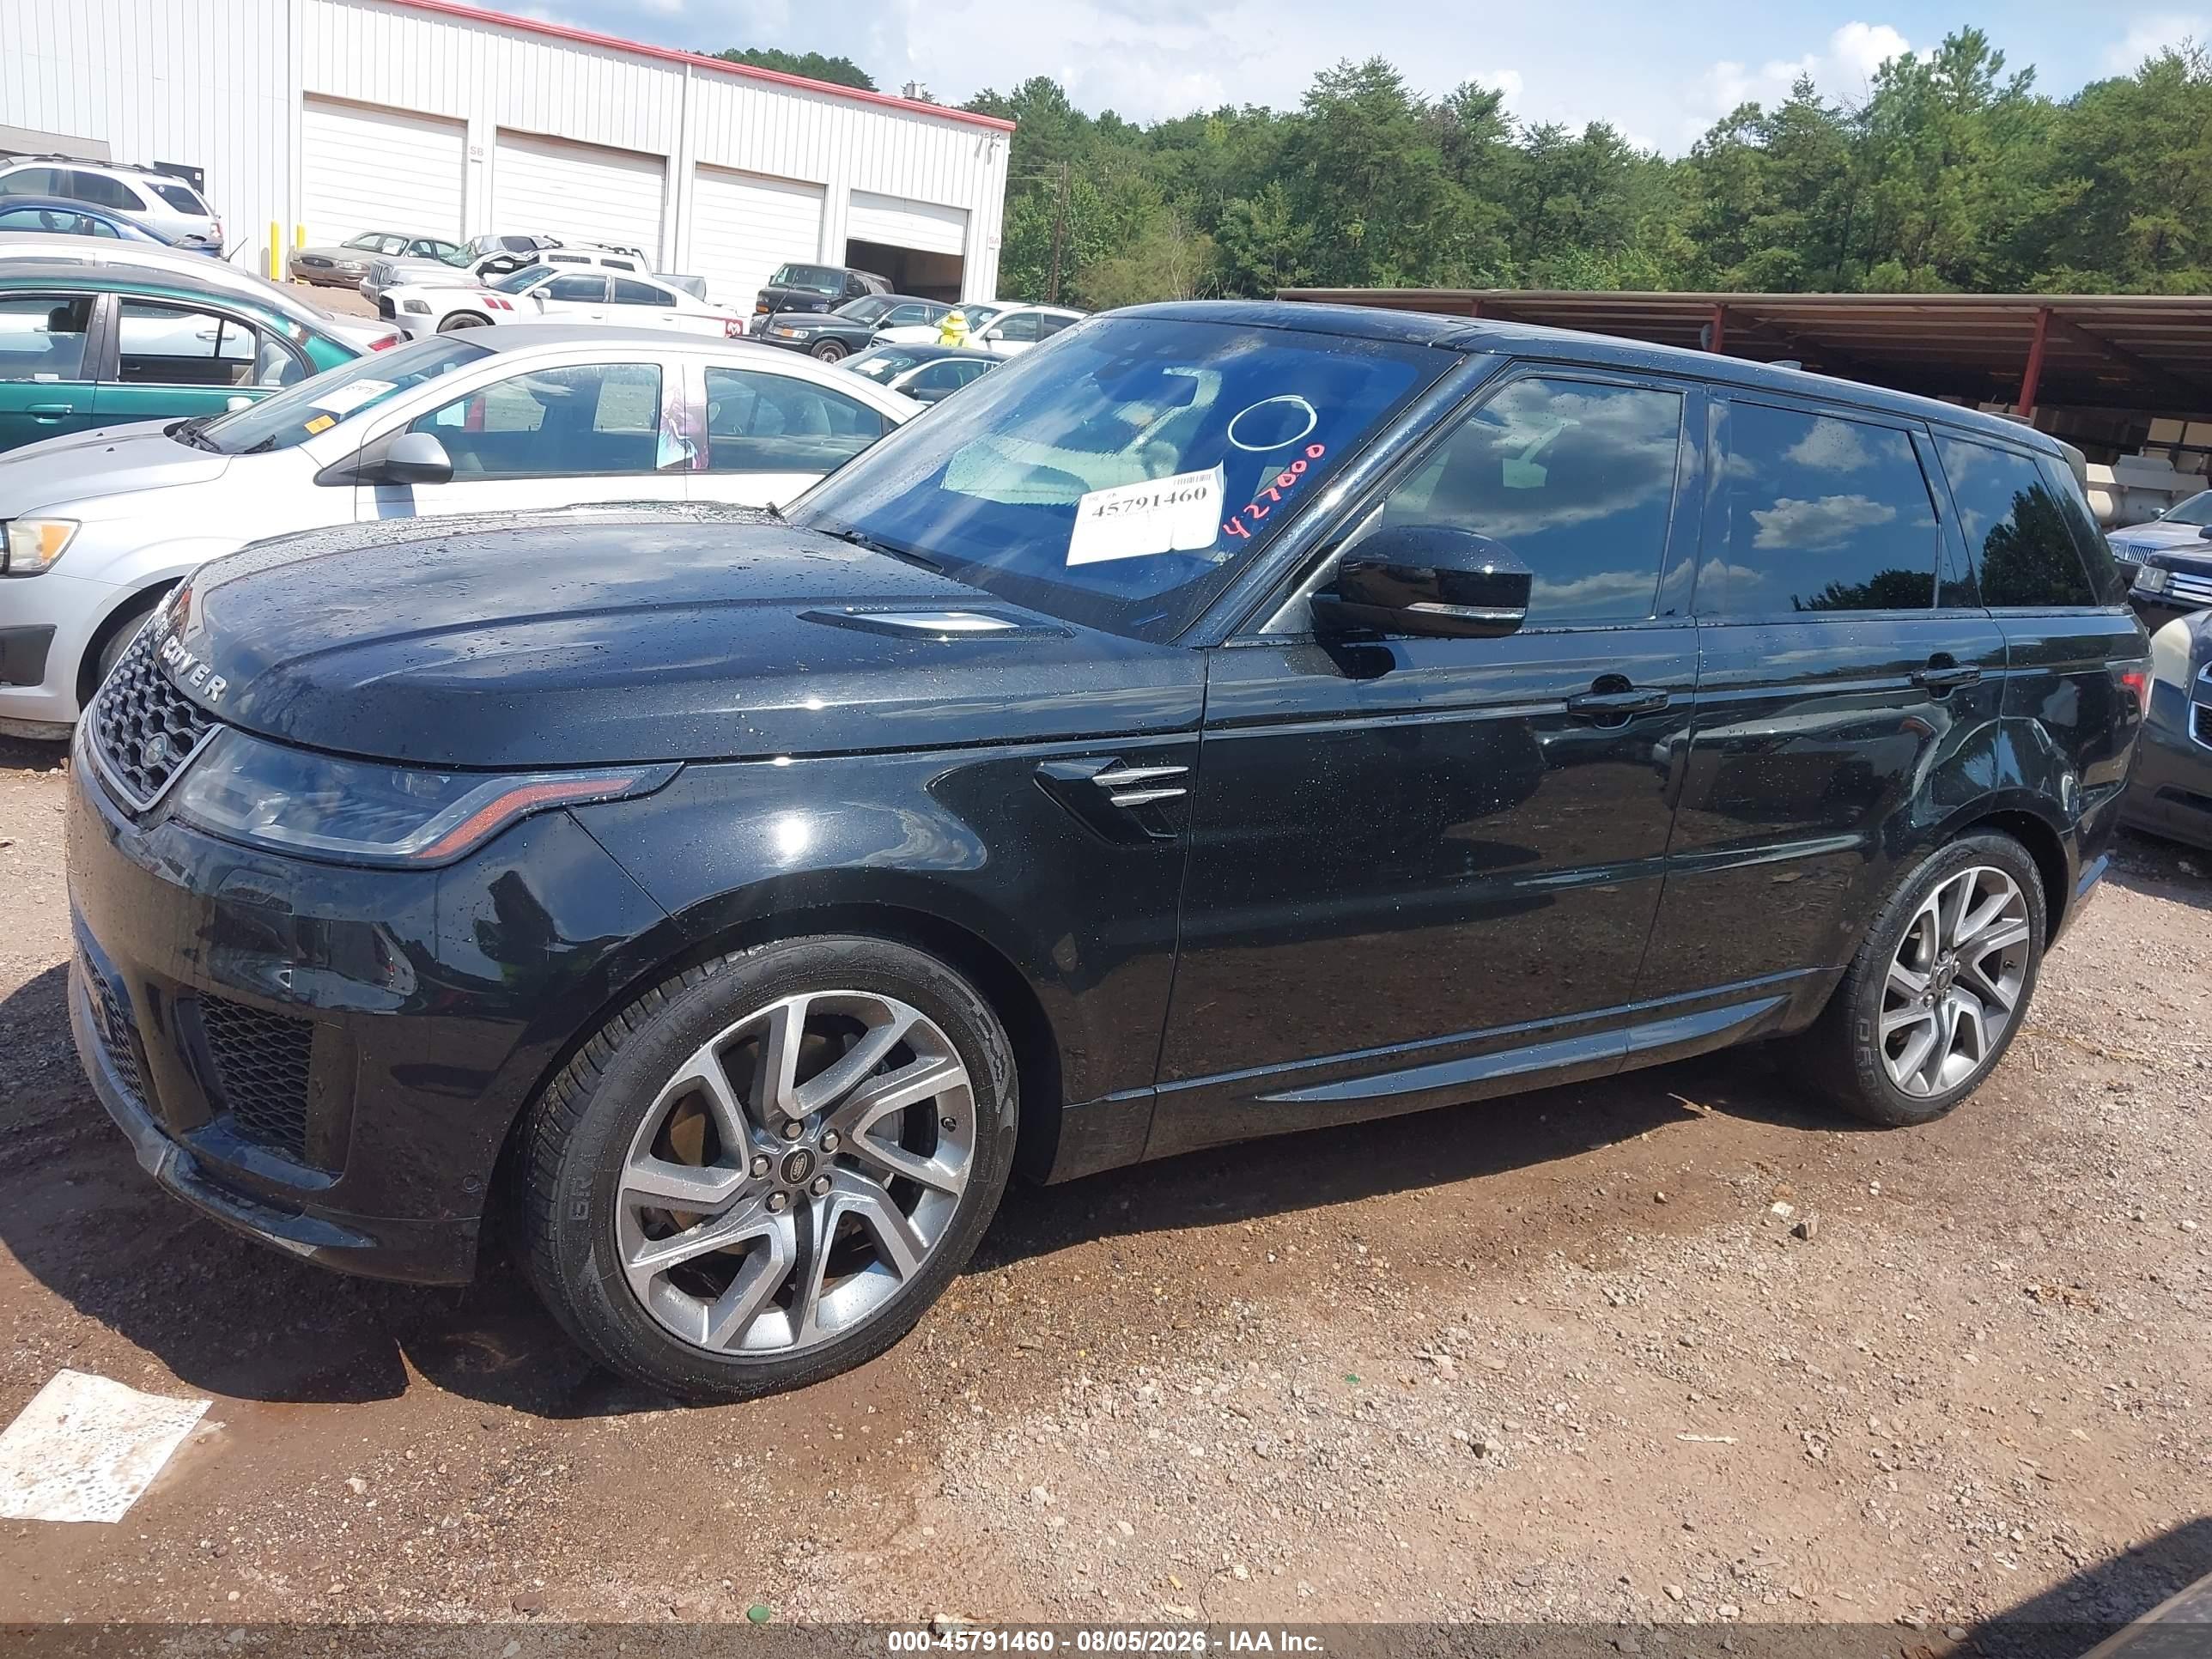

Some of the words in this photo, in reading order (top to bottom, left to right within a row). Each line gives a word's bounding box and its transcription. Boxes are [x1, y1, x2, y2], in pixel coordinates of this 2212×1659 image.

[1091, 486, 1207, 518] 45791460
[1223, 444, 1325, 538] 427000
[161, 634, 227, 702] ROVER
